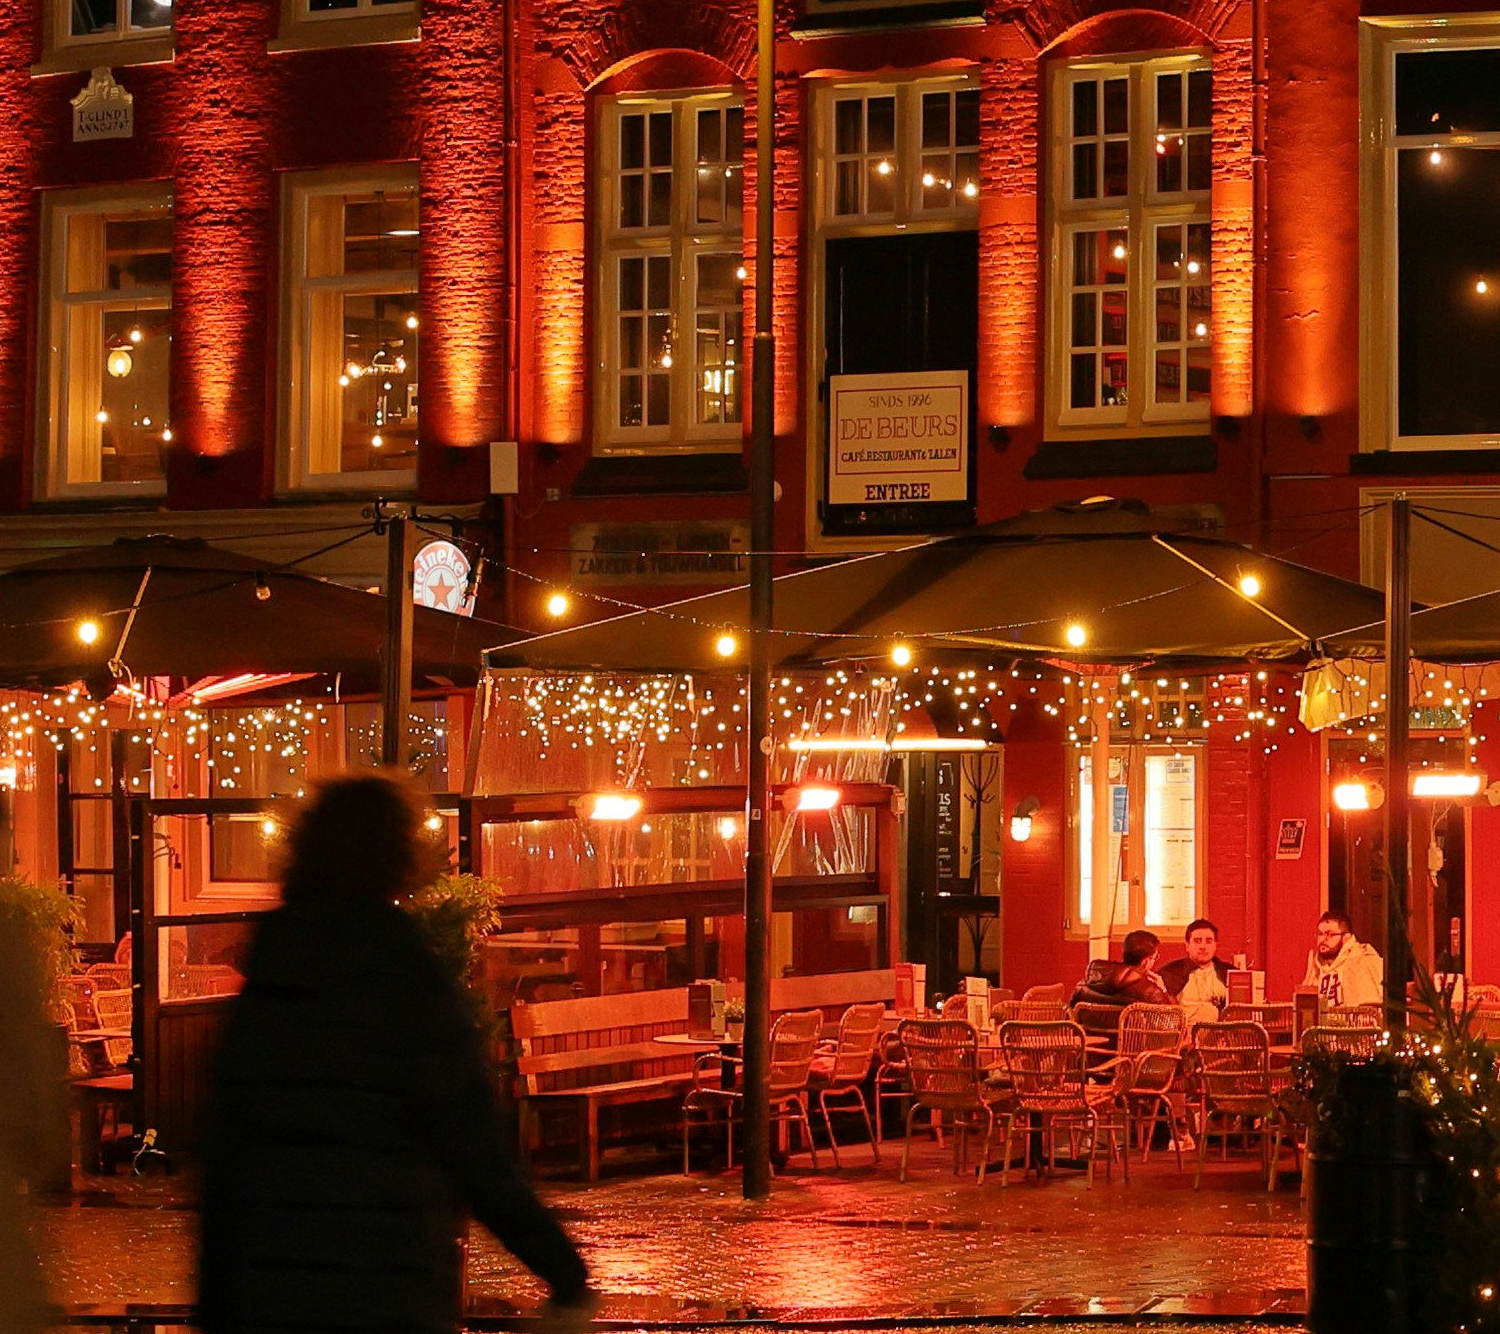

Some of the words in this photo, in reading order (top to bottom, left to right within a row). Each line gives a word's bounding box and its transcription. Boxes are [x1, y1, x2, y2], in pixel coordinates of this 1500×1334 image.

[869, 394, 903, 408] SINDS
[840, 417, 872, 441] DE
[876, 414, 958, 439] BEURS
[928, 448, 957, 460] ZALEN
[864, 482, 931, 501] ENTREE
